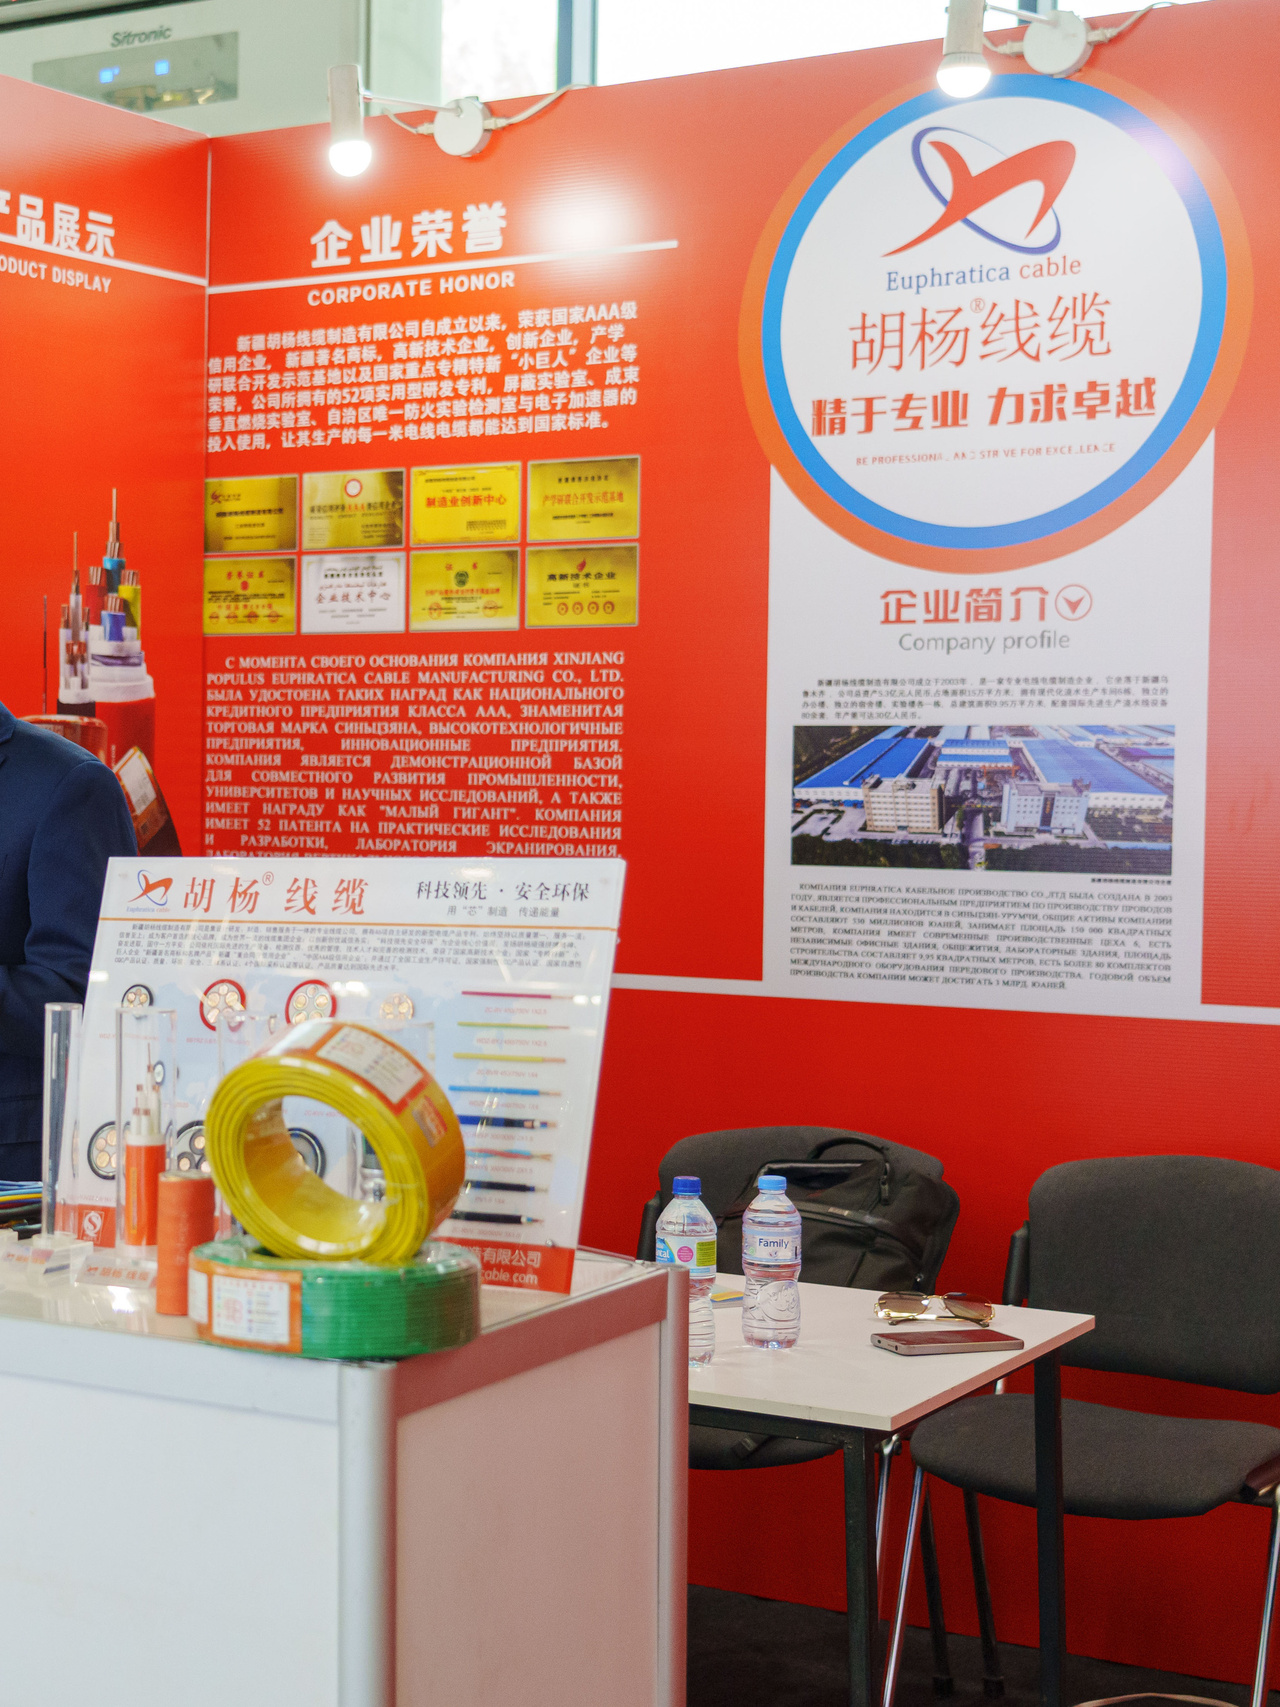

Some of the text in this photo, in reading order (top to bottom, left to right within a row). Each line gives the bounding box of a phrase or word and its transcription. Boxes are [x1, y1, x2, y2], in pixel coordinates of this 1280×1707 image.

[110, 25, 172, 49] Sitronic
[309, 201, 508, 268] 企业荣誉
[52, 266, 112, 293] DISPLAY
[886, 255, 1082, 295] Euphratica cable
[307, 271, 515, 307] CORPORATE HONOR
[811, 377, 1156, 437] 精于专业 力求卓越
[879, 584, 1050, 625] 企业简介
[899, 630, 1070, 655] Company profile
[224, 651, 624, 669] С МОМЕНТА СВОЕГО ОСНОВАНИЯ КОМПАНИЯ XINJIANG
[206, 672, 265, 685] POPULUS
[271, 672, 356, 684] EUPHRATICA
[363, 671, 410, 684] CABLE
[418, 670, 544, 683] MANUFACTURING
[590, 669, 623, 682] LTD.
[206, 686, 624, 702] БЫЛА УДОСТОЕНА ТАКИХ НАГРАД КАК НАЦИОНАЛЬНОГО
[206, 705, 293, 718] КРЕДИТНОГО
[300, 704, 399, 718] ПРЕДПРИЯТИЯ
[408, 704, 466, 717] КЛАССА
[520, 704, 623, 717] ЗНАМЕНИТАЯ
[206, 721, 623, 735] ТОРГОВАЯ МАРКА СИНЬЦЗЯНА, ВЫСОКОТЕХНОЛОГИЧНЫЕ
[206, 753, 622, 769] КОМПАНИЯ ЯВЛЯЕТСЯ ДЕМОНСТРАЦИОННОЙ БАЗОЙ
[204, 769, 232, 782] ДЛЯ
[251, 770, 353, 783] СОВМЕСТНОГО
[373, 771, 445, 784] РАЗВИТИЯ
[205, 785, 622, 804] УНИВЕРСИТЕТОВ И НАУЧНЫХ ИССЛЕДОВАНИЙ, А ТАКЖЕ
[758, 1238, 790, 1249] Family
